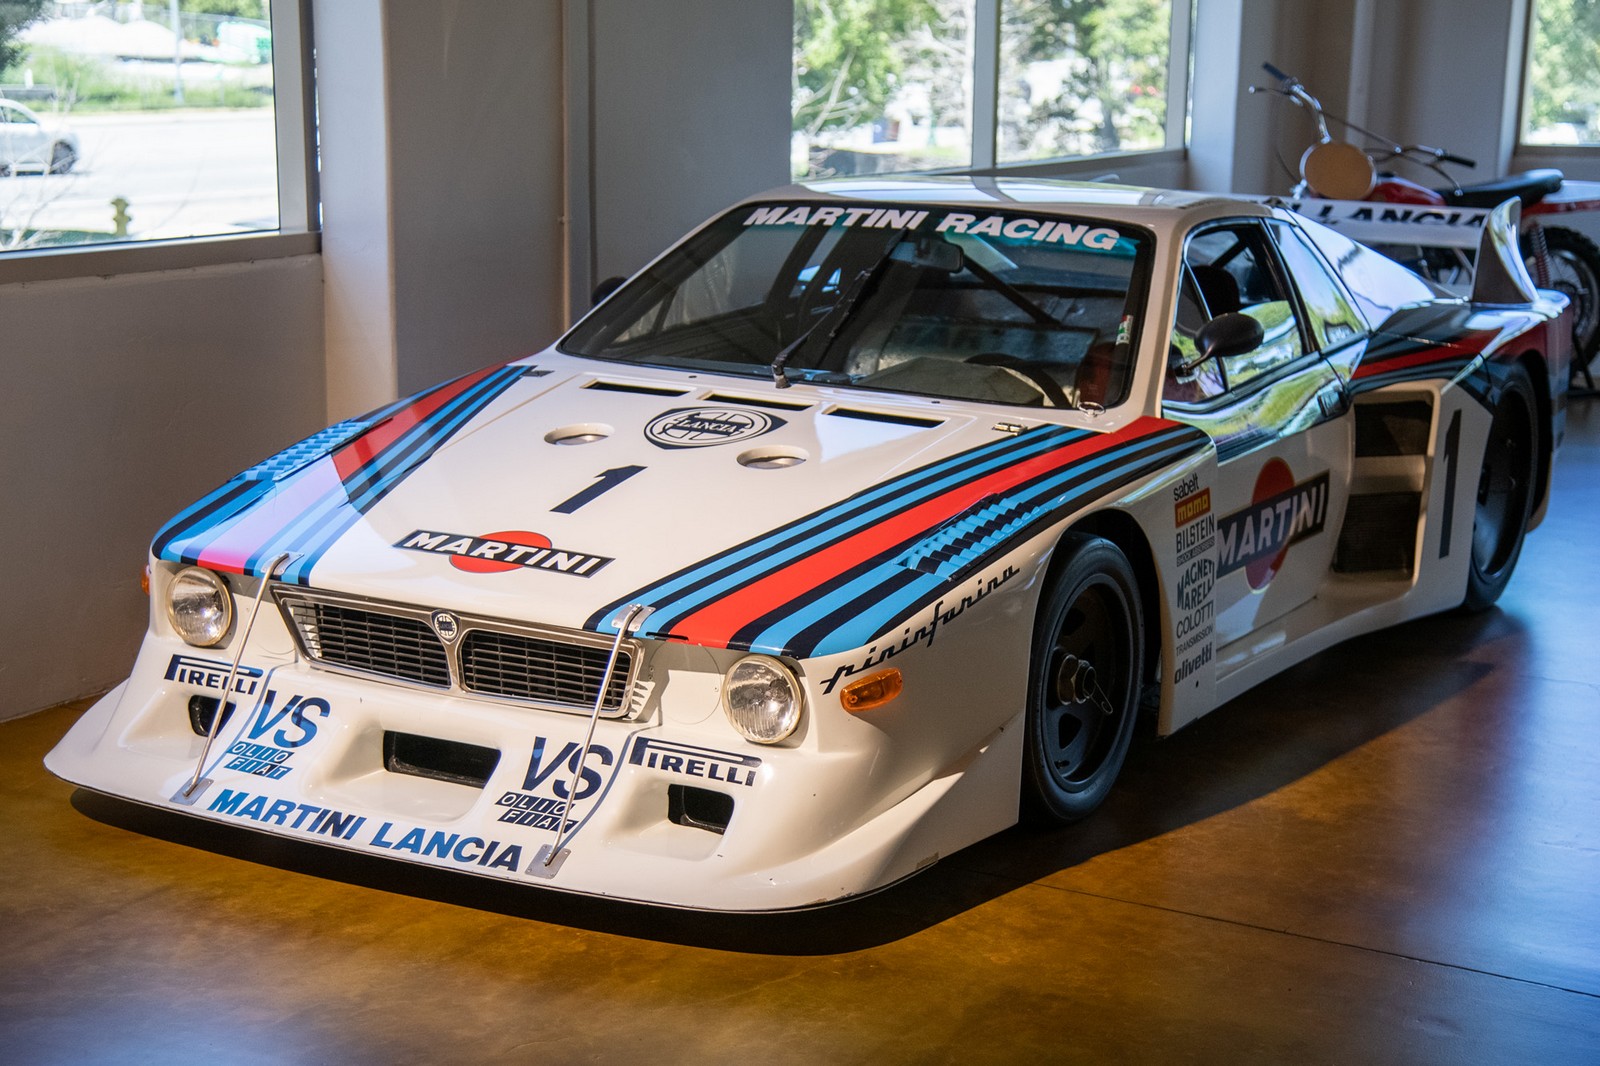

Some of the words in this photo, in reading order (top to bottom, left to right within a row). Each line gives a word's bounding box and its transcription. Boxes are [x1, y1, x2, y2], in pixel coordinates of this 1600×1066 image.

[743, 206, 929, 230] MARTINI
[935, 212, 1121, 251] RACING
[677, 419, 738, 433] LANCIA
[549, 465, 648, 514] 1
[1173, 472, 1200, 501] sabelt
[1439, 409, 1462, 559] 1
[1177, 494, 1209, 522] momo
[1217, 483, 1326, 566] MARTINI
[402, 532, 601, 575] MARTINI
[1176, 513, 1215, 554] BILSTEIN
[1177, 558, 1215, 593] MAGNETI
[1177, 576, 1215, 611] MARELLI
[820, 565, 1020, 696] pininfarina
[1176, 601, 1214, 639] COLOTTI
[164, 654, 264, 695] PIRELLI
[1174, 642, 1213, 685] olivetti
[247, 689, 331, 748] VS
[227, 757, 291, 778] FIAT
[230, 742, 291, 764] OLIO
[521, 736, 614, 800] VS
[629, 736, 763, 787] PIRELLI
[207, 789, 367, 841] MARTINI
[369, 822, 523, 872] LANCIA
